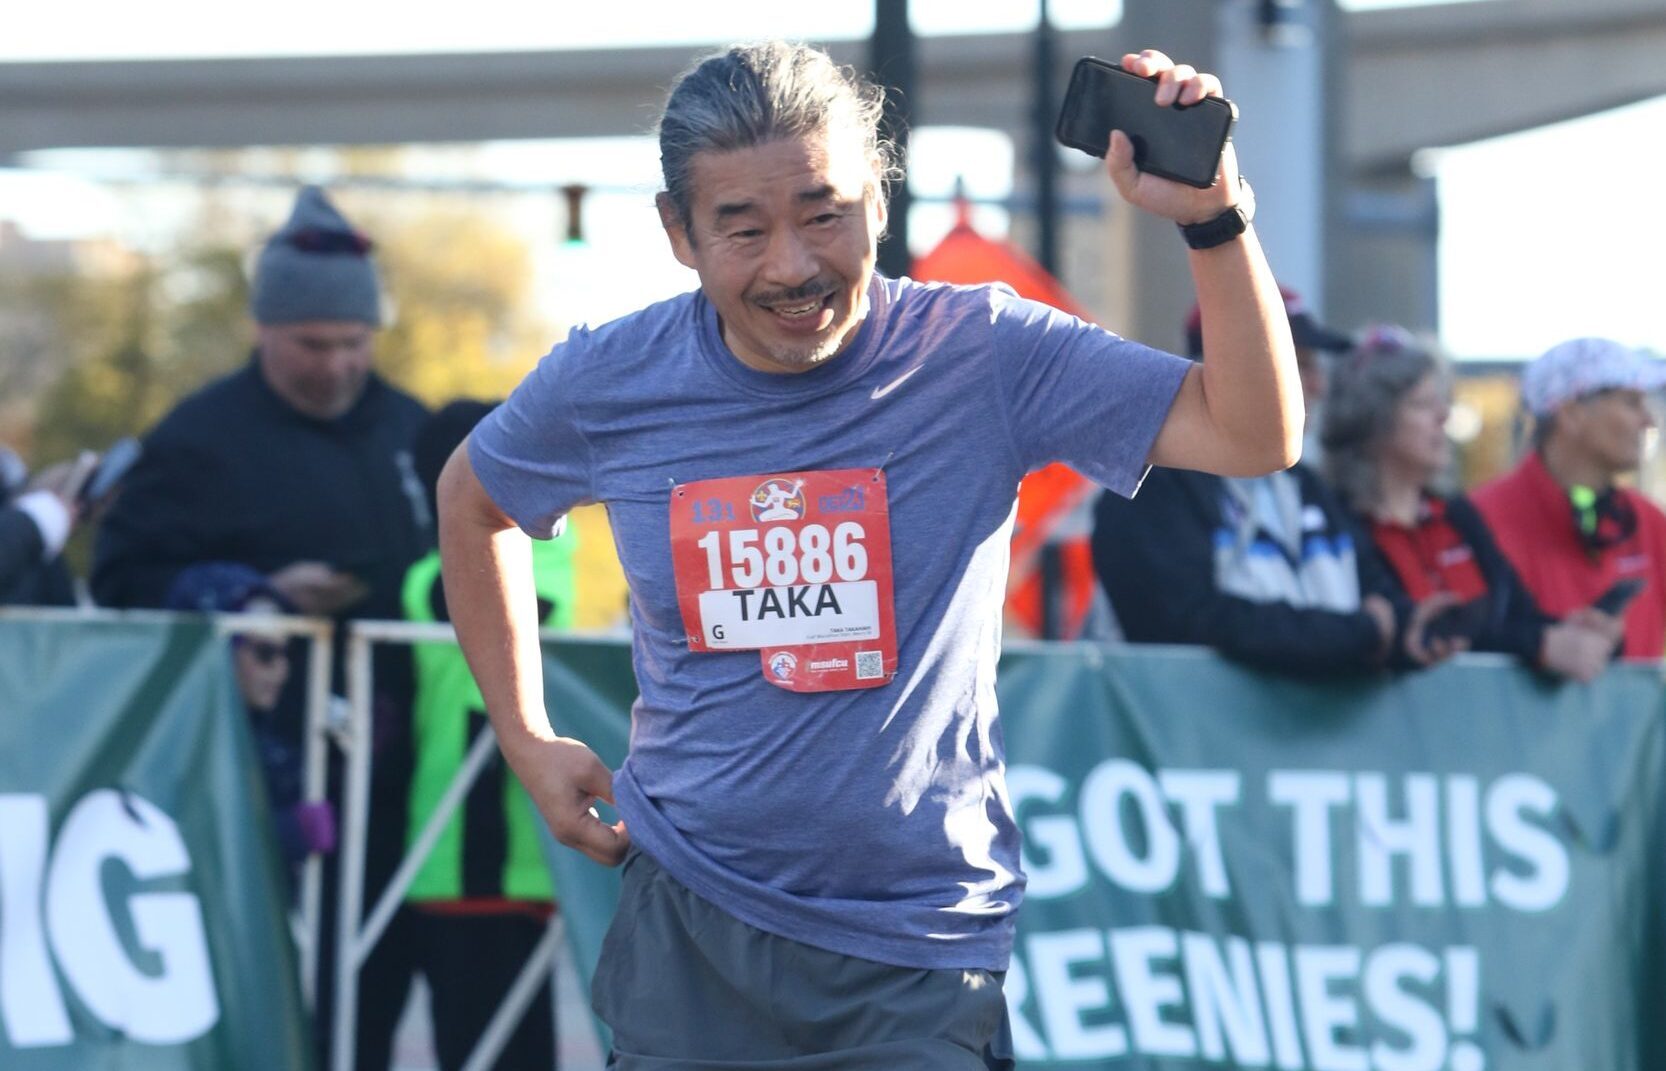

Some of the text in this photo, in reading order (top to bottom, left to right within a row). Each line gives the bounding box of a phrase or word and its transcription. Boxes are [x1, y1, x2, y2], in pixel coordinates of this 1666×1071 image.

[698, 521, 869, 590] 15886
[733, 584, 842, 622] TAKA
[712, 624, 725, 640] G
[1004, 758, 1570, 913] GOT THIS
